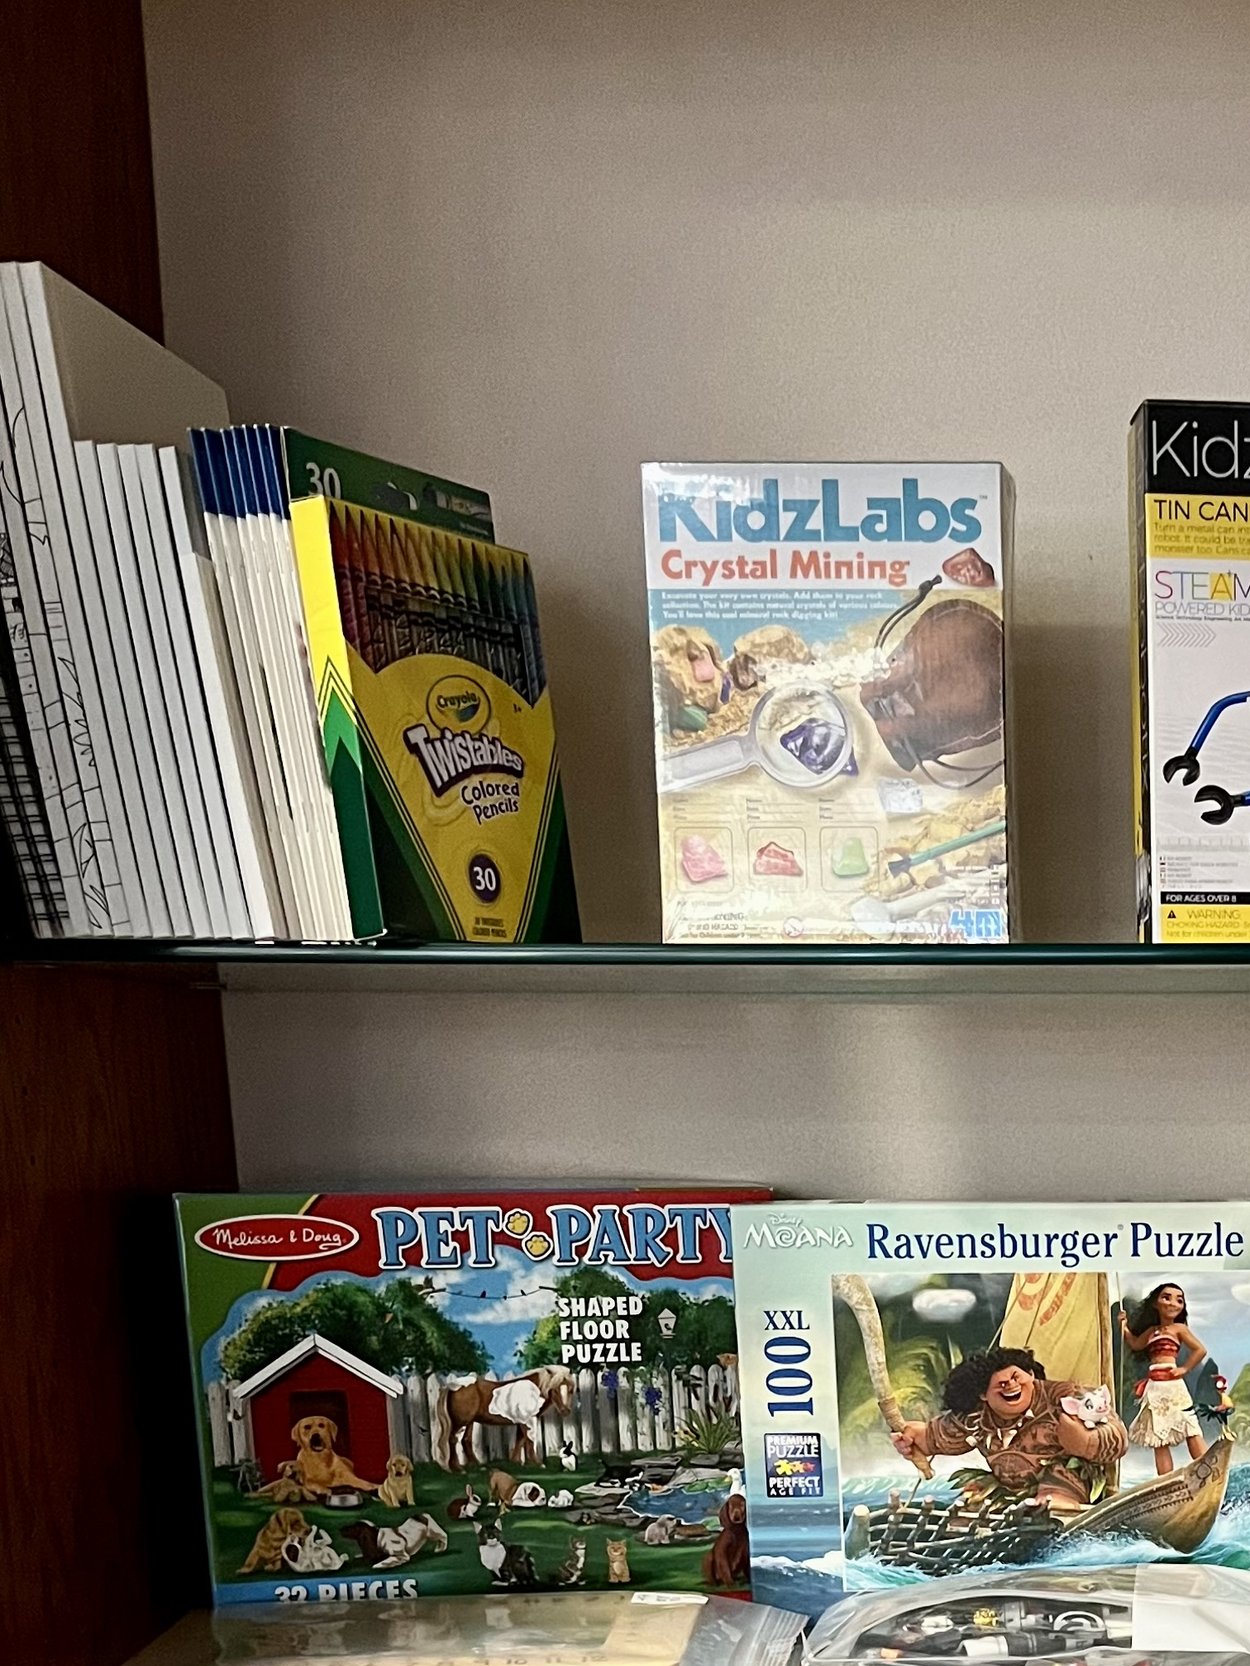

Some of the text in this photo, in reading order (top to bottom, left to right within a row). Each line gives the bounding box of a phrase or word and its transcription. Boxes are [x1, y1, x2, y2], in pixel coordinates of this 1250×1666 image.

[306, 462, 339, 500] 30
[659, 478, 982, 542] KidzLabs
[1154, 500, 1190, 521] TIN
[1199, 501, 1248, 522] CAN
[662, 549, 909, 586] Crystal Mining
[1155, 602, 1225, 615] POWERED
[438, 692, 480, 708] Crayola
[407, 725, 522, 788] Twistables
[461, 781, 519, 804] Colored
[474, 798, 518, 825] Pencils
[473, 867, 496, 891] 30
[1166, 894, 1182, 902] FOR
[213, 1227, 283, 1247] Melissa
[302, 1226, 343, 1251] Doug
[374, 1206, 733, 1269] PET PARTY
[744, 1221, 854, 1248] MOANA
[867, 1222, 1244, 1269] Ravensburger Puzzle
[558, 1297, 643, 1318] SHAPED
[560, 1321, 630, 1340] FLOOR
[764, 1310, 810, 1330] XXL
[561, 1343, 642, 1363] PUZZLE
[764, 1336, 814, 1417] 100
[767, 1434, 818, 1446] PREMIUM
[767, 1445, 818, 1458] PUZZLE
[769, 1477, 820, 1488] PERFECT
